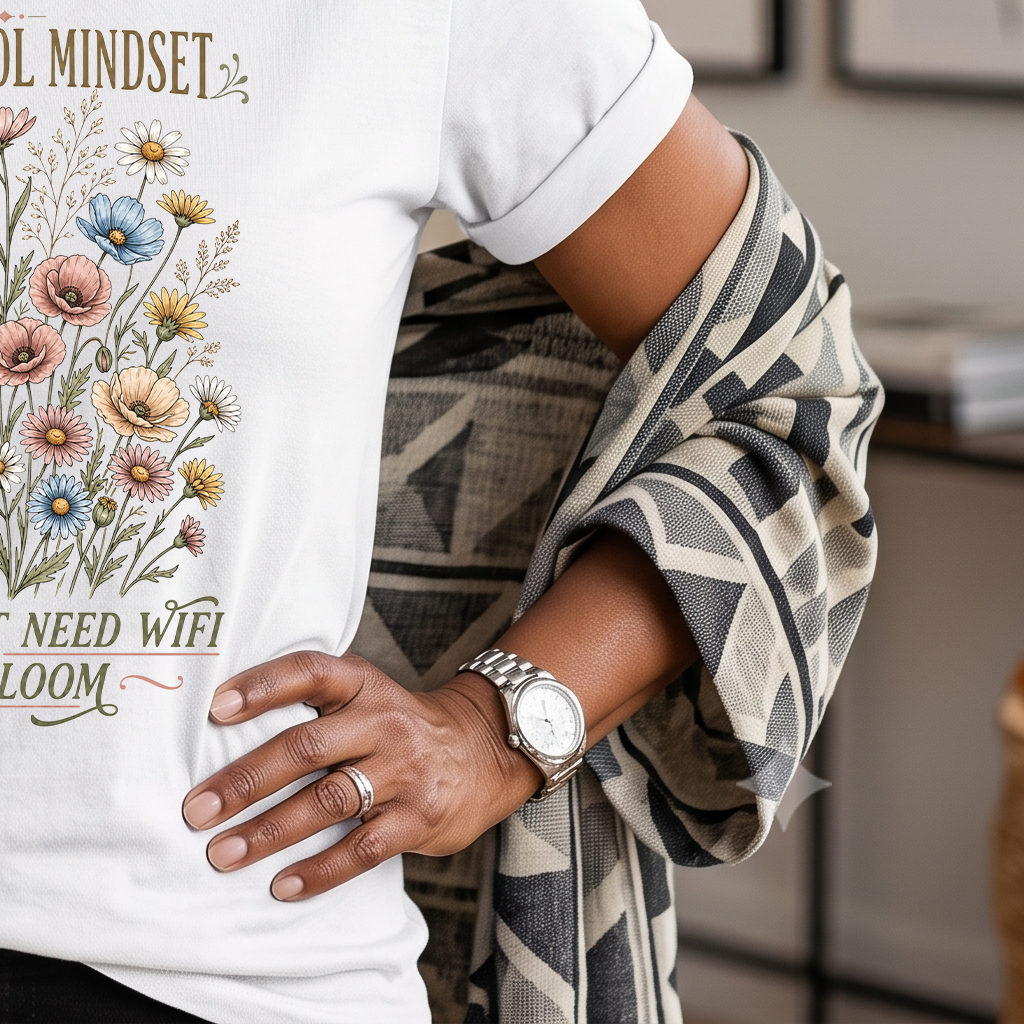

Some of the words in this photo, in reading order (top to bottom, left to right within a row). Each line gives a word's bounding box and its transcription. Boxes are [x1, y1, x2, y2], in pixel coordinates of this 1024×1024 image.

[48, 28, 214, 100] MINDSET
[20, 611, 122, 648] NEED
[140, 596, 225, 648] WIFI
